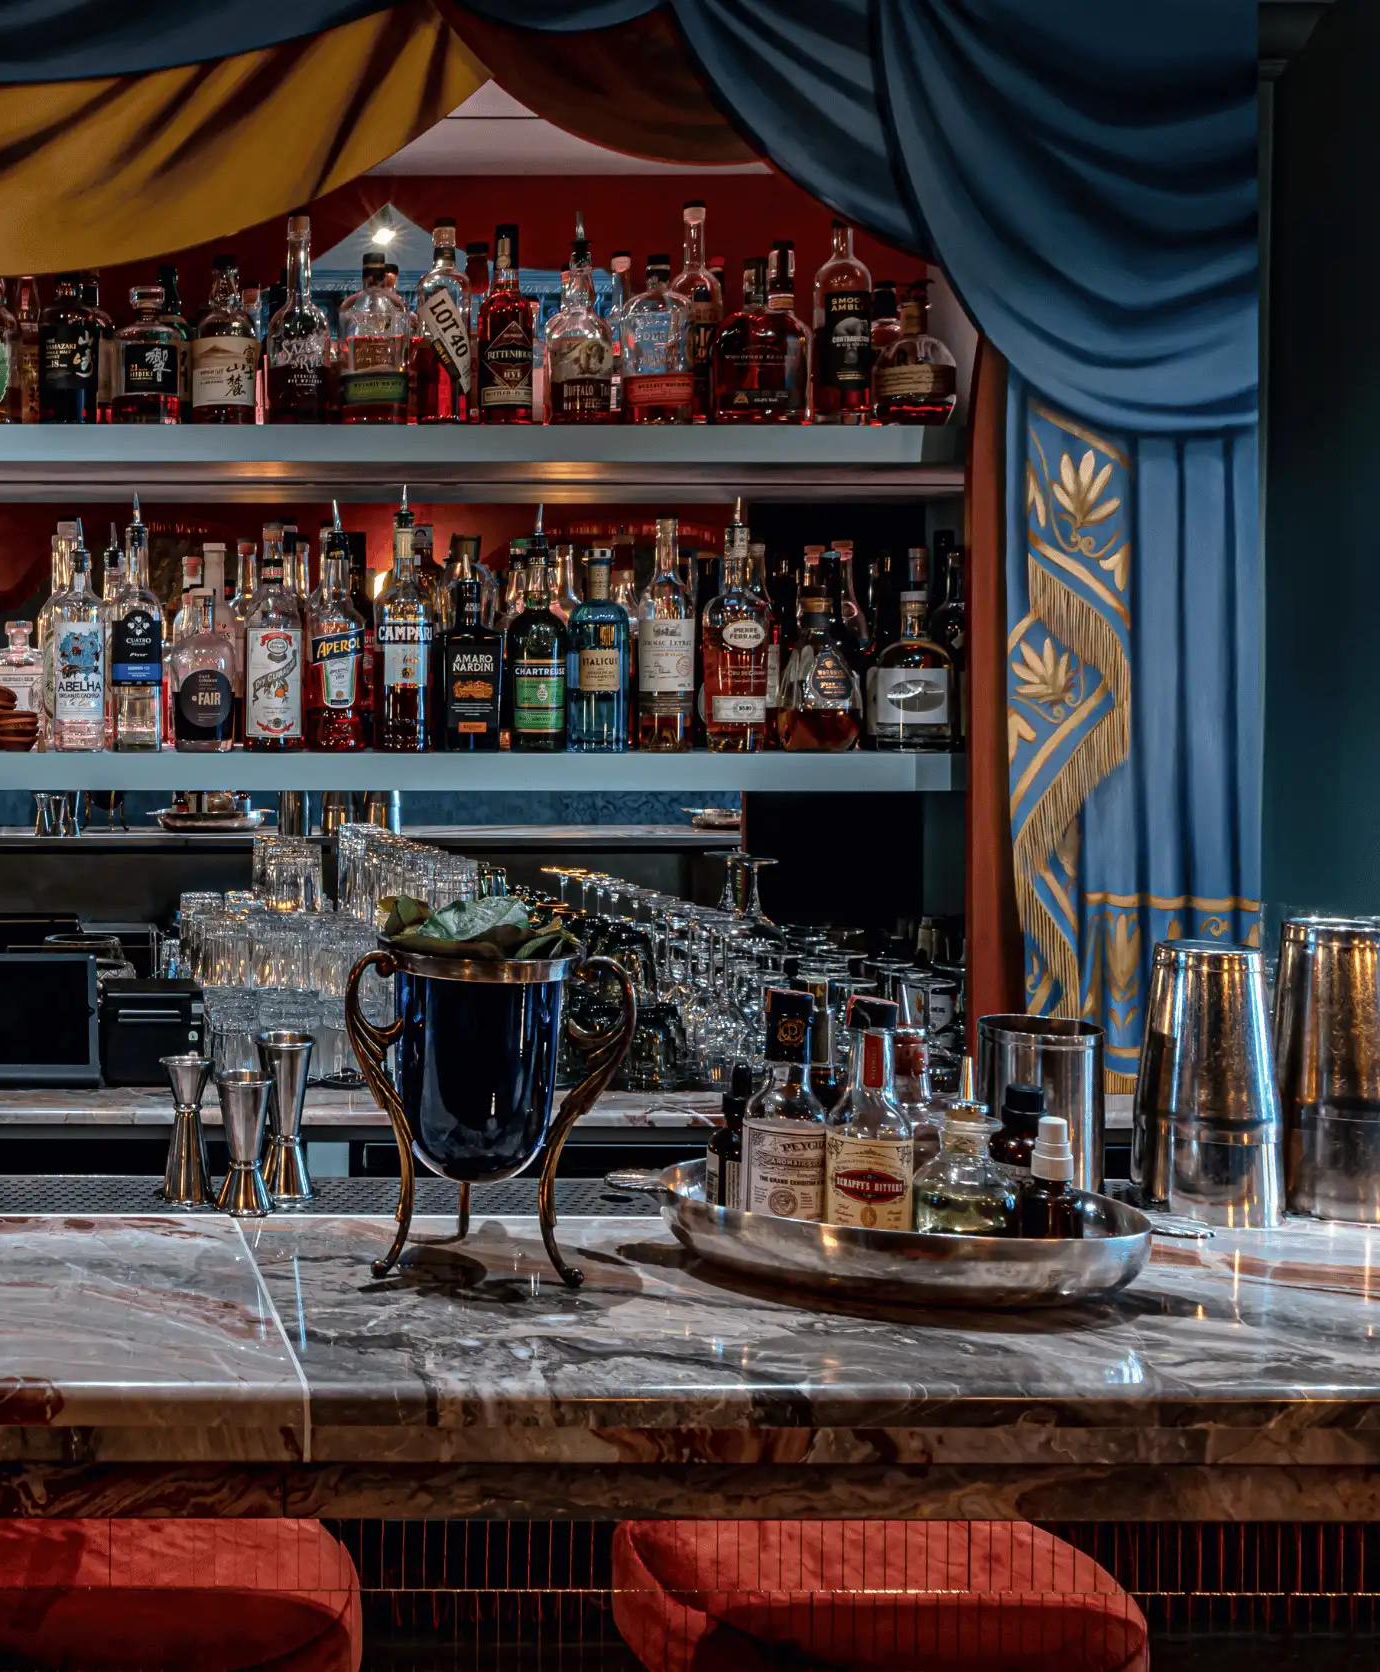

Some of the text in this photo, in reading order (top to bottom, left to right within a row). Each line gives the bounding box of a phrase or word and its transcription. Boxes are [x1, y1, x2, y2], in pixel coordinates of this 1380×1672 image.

[428, 298, 469, 359] LOT 40
[563, 383, 594, 398] BUFFALO
[377, 625, 434, 642] CAMPARI
[316, 638, 361, 660] APEROL
[454, 654, 493, 664] AMARO
[452, 662, 495, 672] NARDINI
[514, 667, 566, 676] CHARTREUSE
[57, 681, 103, 693] ABELHA
[198, 691, 221, 706] FAIR
[836, 1176, 904, 1193] SCRAPPY'S BITTERS
